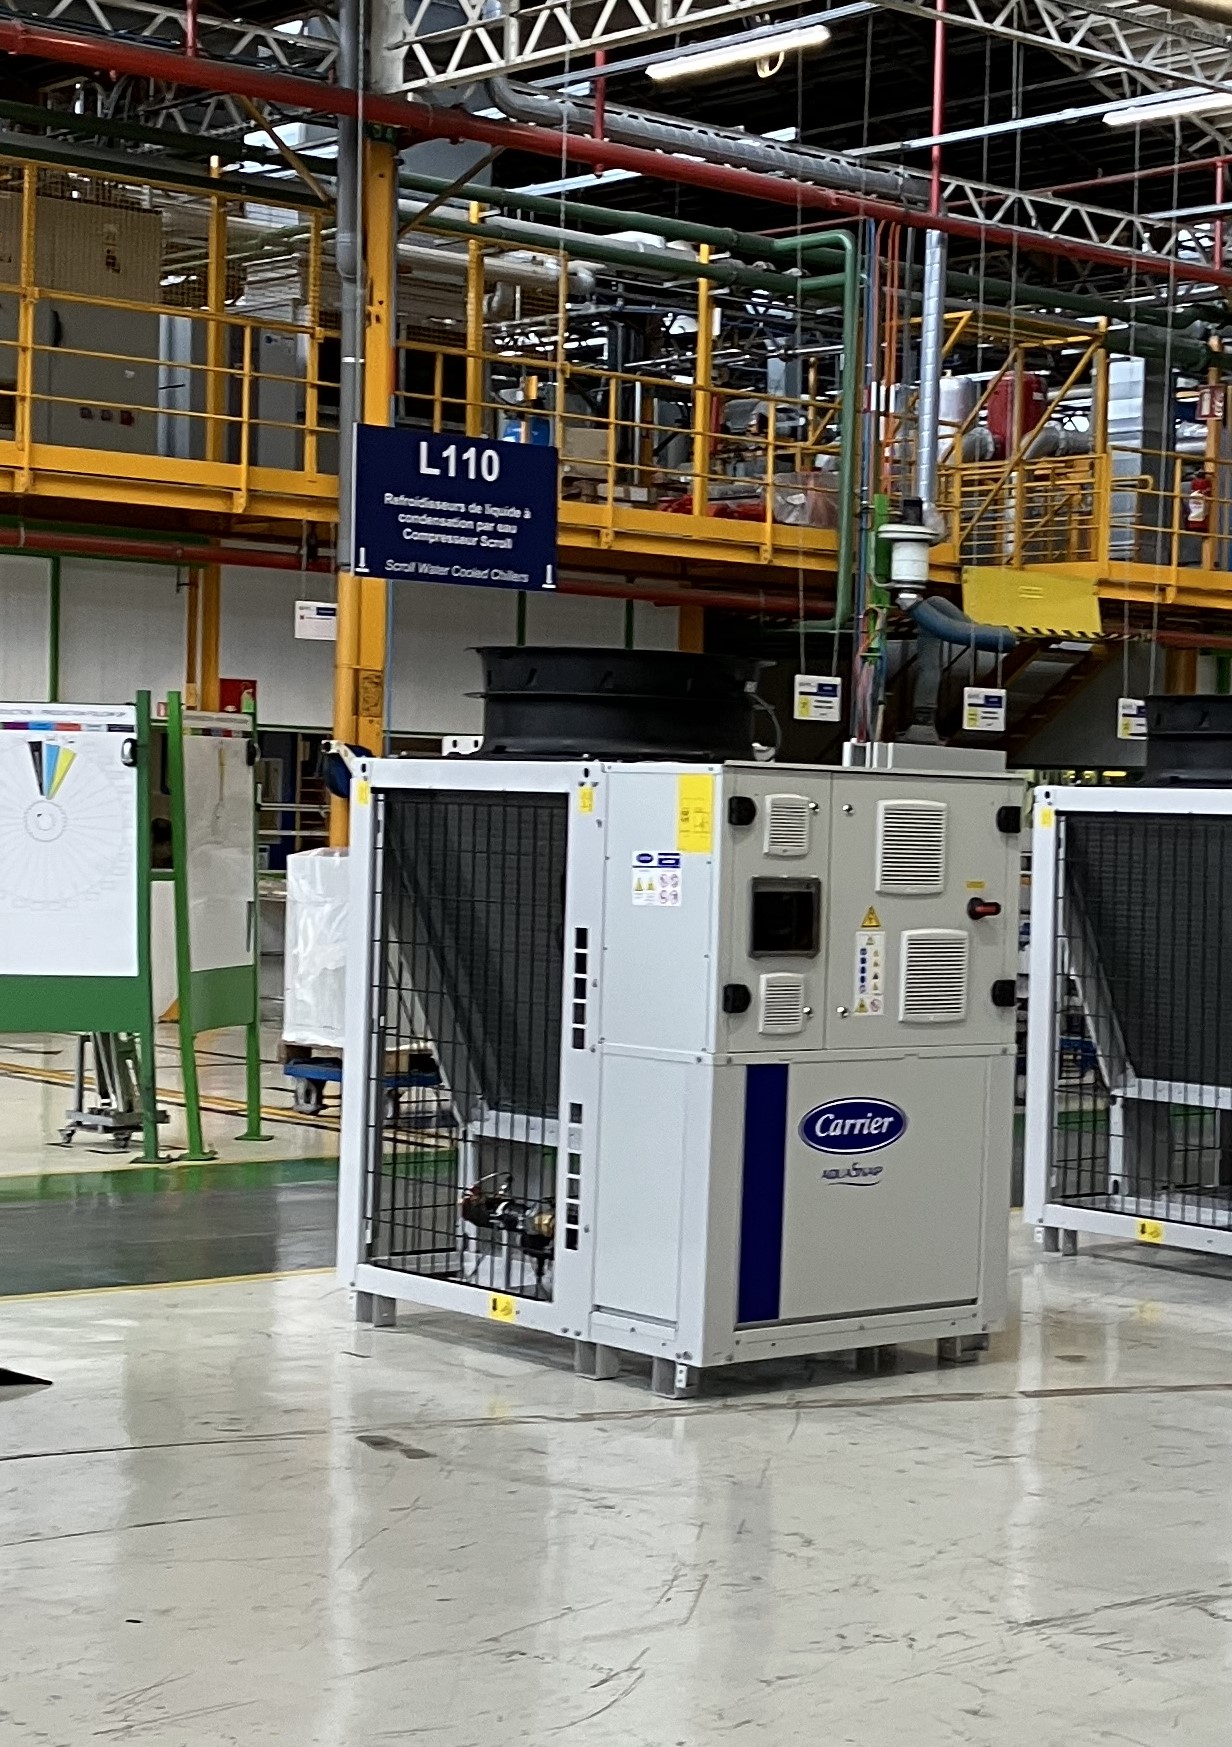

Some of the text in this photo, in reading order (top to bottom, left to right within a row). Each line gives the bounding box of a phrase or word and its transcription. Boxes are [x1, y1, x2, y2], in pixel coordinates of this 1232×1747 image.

[419, 441, 500, 482] L110
[384, 492, 466, 513] Refroidisseurs
[468, 502, 483, 514] de
[484, 503, 522, 518] liquide
[398, 513, 474, 530] condensation
[476, 521, 495, 532] par
[402, 528, 514, 549] Compresseur Scroll
[384, 559, 530, 583] Scroll Water Cooled Chillers
[815, 1112, 894, 1137] Carrier
